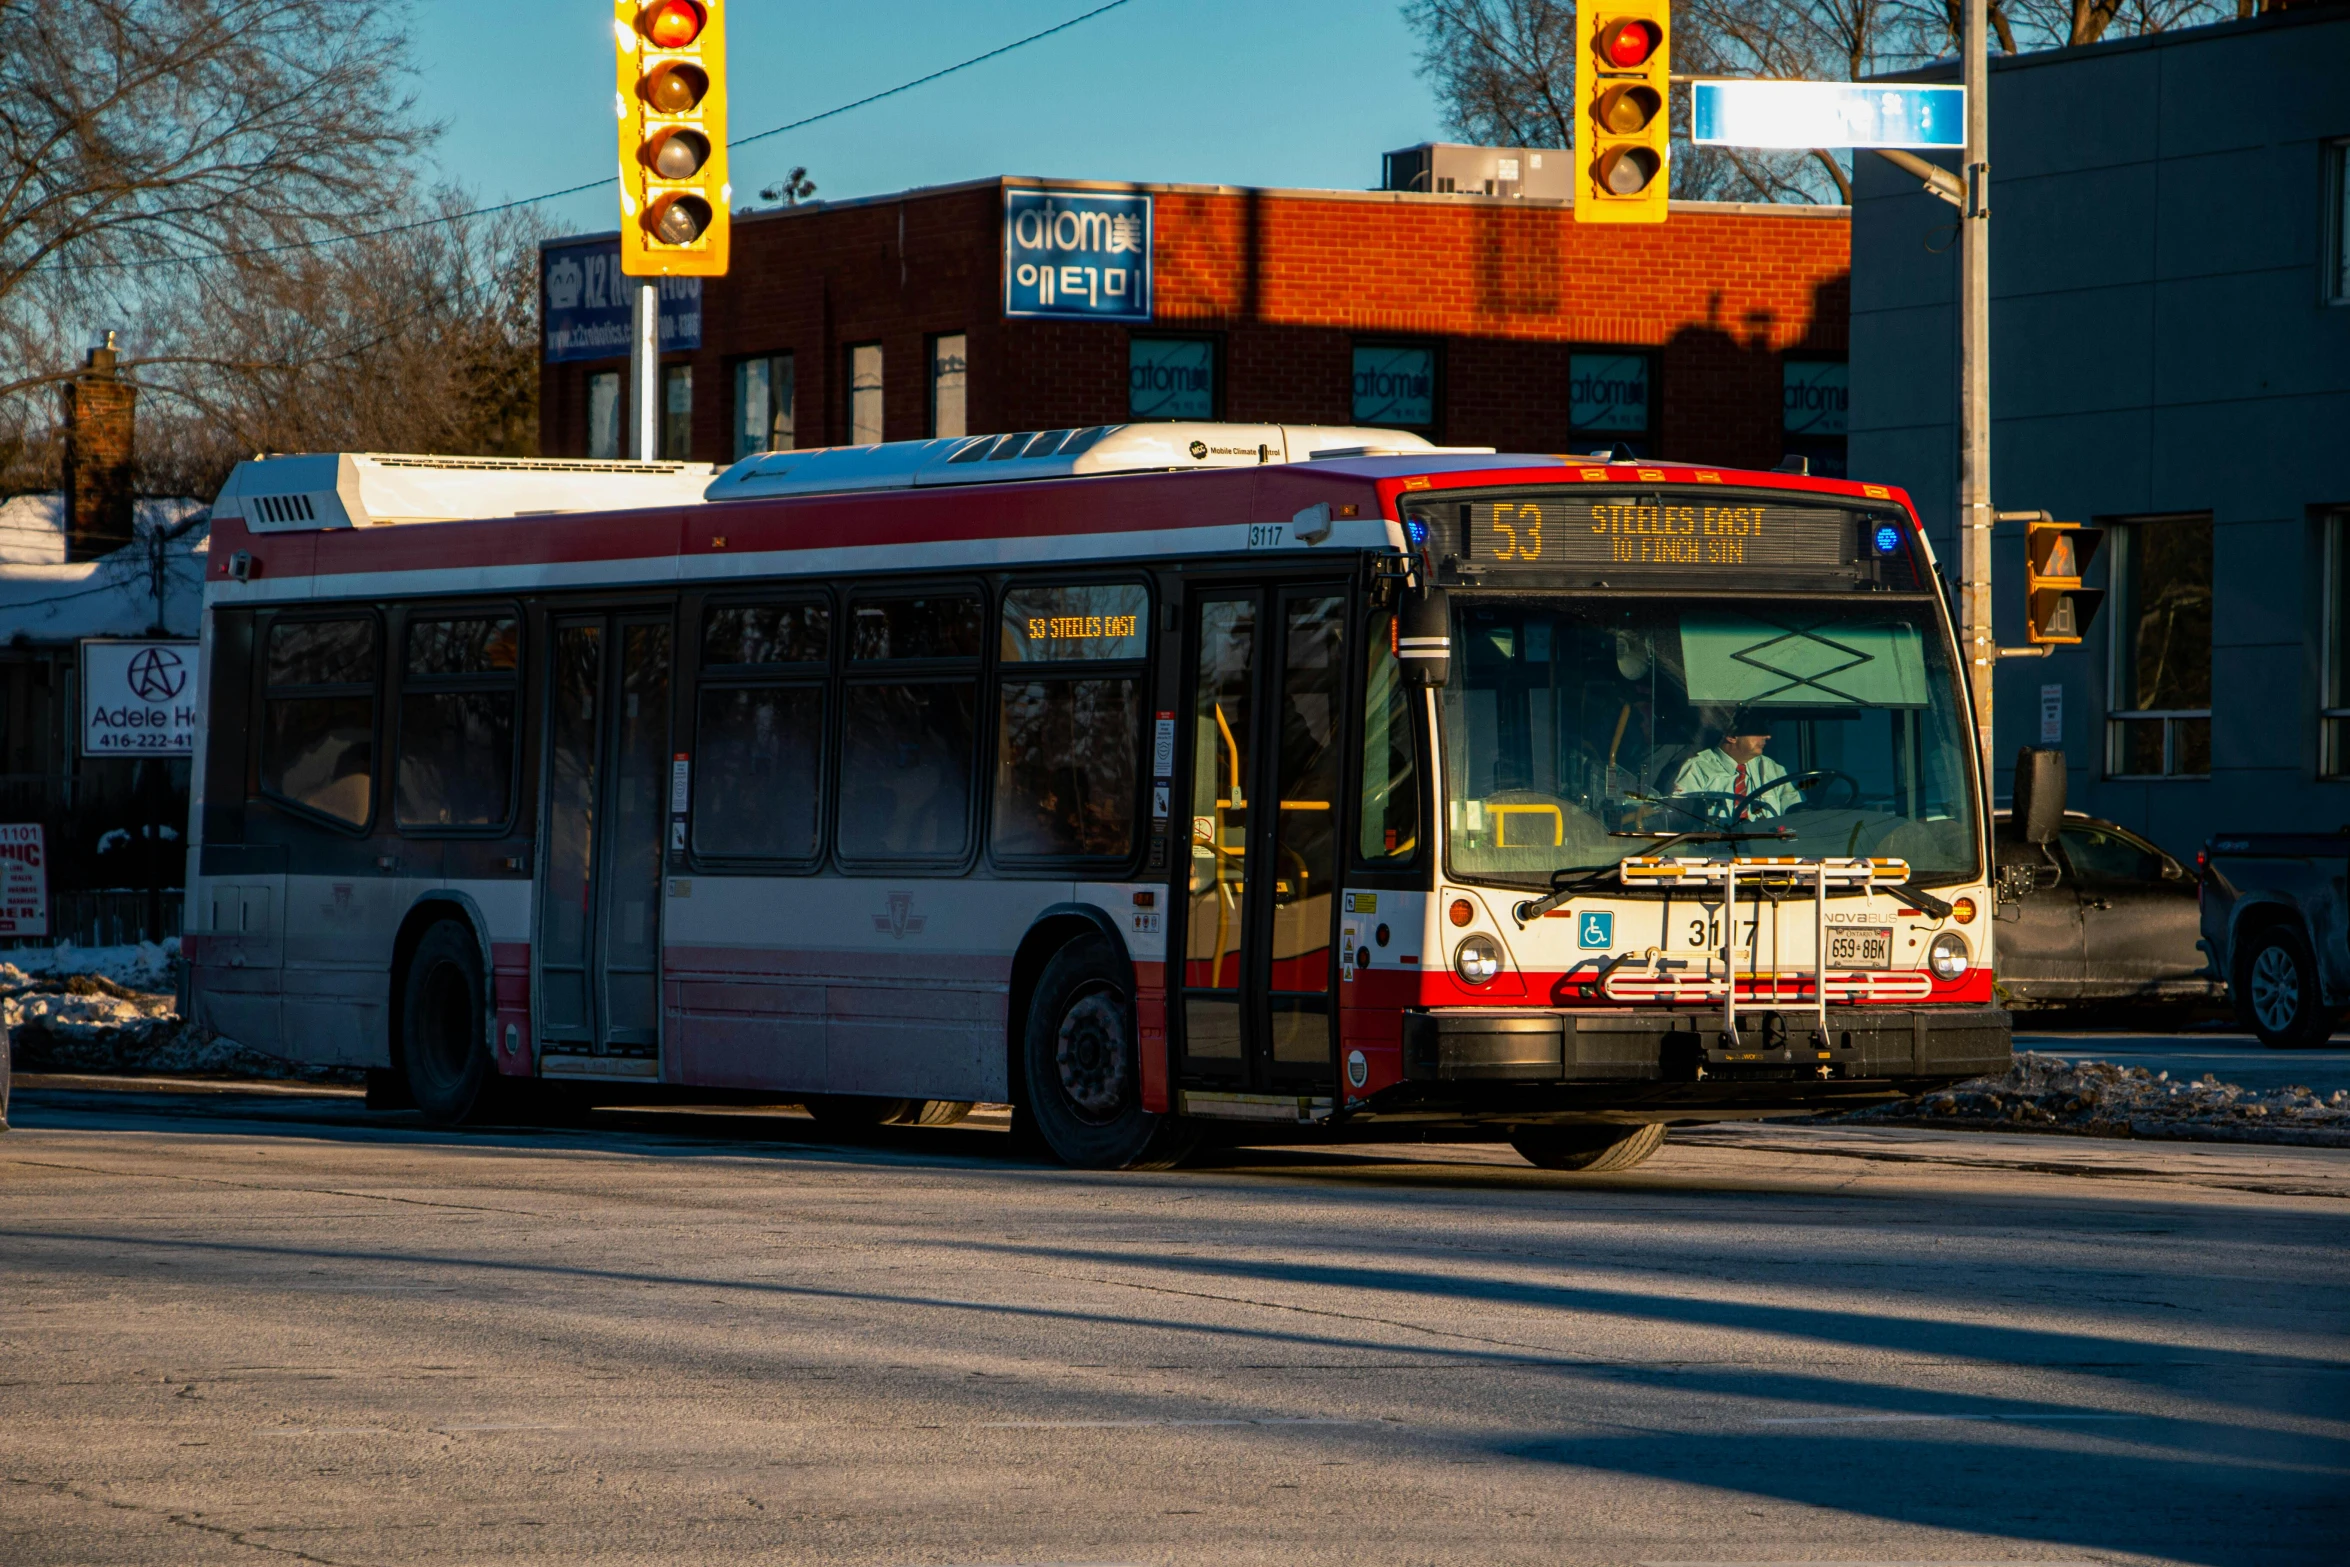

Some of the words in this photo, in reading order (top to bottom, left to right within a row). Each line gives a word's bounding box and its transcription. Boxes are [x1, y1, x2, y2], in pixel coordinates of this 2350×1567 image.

[584, 254, 606, 309] X2
[1016, 264, 1140, 308] 애터미
[1210, 447, 1232, 455] Mobile
[1233, 447, 1257, 456] Climate
[1258, 448, 1281, 456] ntrol
[1493, 503, 1542, 560] 53
[1591, 505, 1694, 535] STEELES
[1704, 507, 1765, 536] EAST
[1251, 526, 1283, 546] 3117
[1612, 537, 1632, 561] TO
[1641, 538, 1699, 562] FINCH
[1708, 539, 1743, 563] STN
[1029, 618, 1046, 639] 53
[1050, 617, 1101, 638] STEELES
[1104, 615, 1137, 637] EAST
[91, 706, 168, 728] Adele
[174, 706, 196, 728] H
[100, 734, 192, 748] 416-222-41
[1846, 930, 1873, 938] ONTARIO
